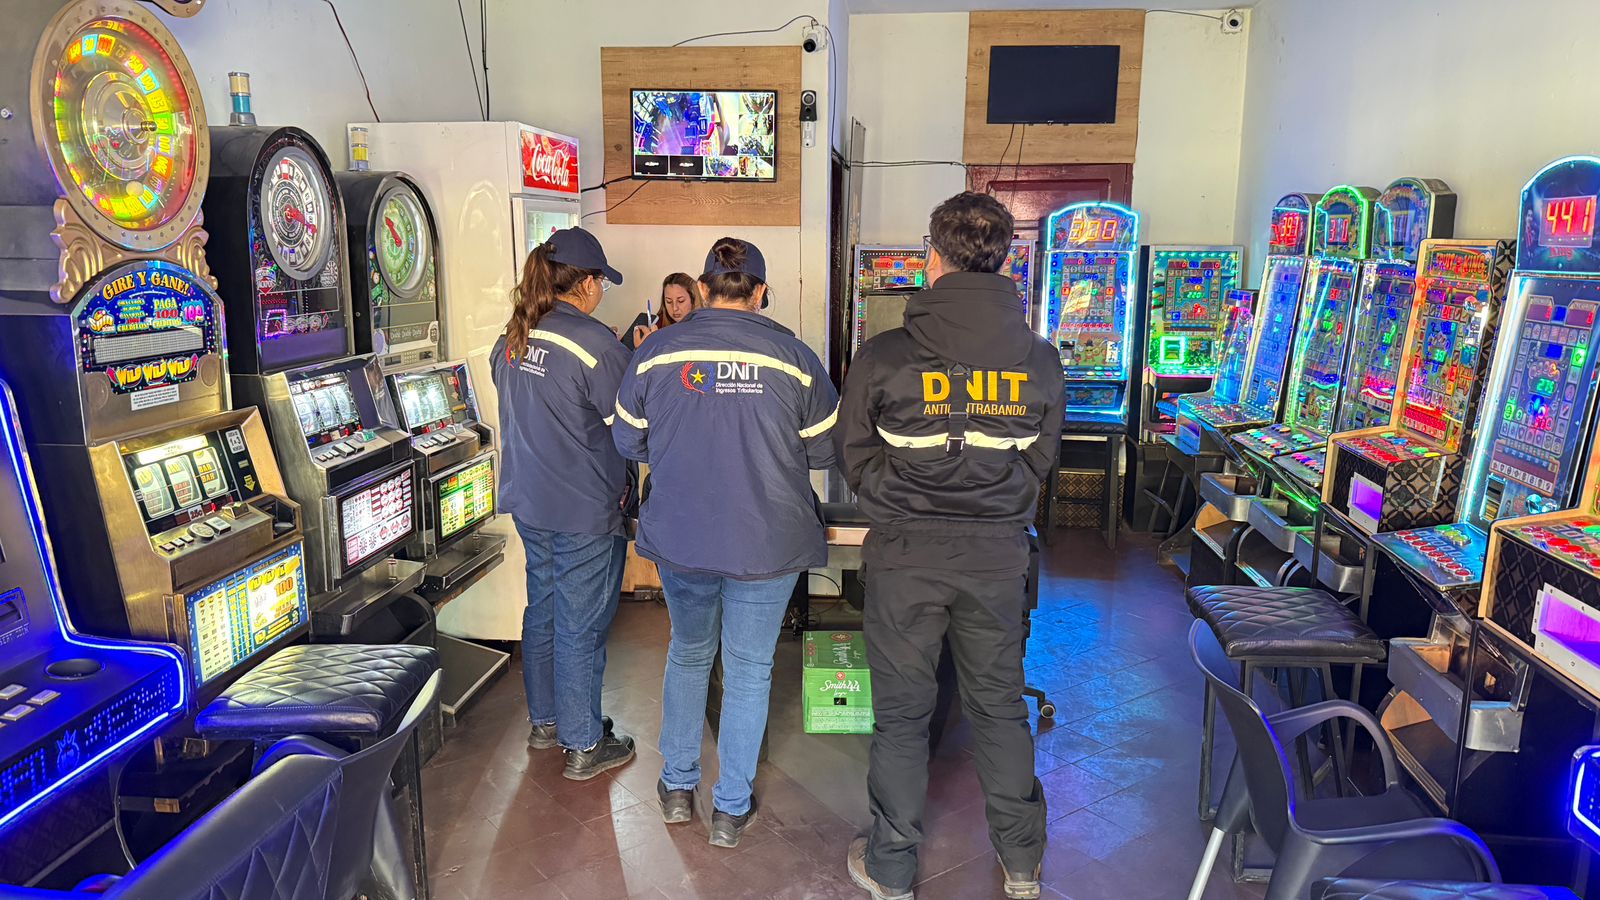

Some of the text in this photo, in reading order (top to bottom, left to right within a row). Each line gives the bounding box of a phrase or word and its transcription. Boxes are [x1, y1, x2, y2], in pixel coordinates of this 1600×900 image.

[1547, 199, 1591, 235] 441
[103, 271, 190, 300] GIRE Y GANE!
[153, 297, 178, 310] PAGA
[156, 309, 178, 319] 100
[116, 356, 191, 387] WILD WILD WILD
[717, 361, 759, 381] DNIT
[921, 370, 1029, 402] DNIT
[923, 402, 1028, 416] ANTINTRABANDO
